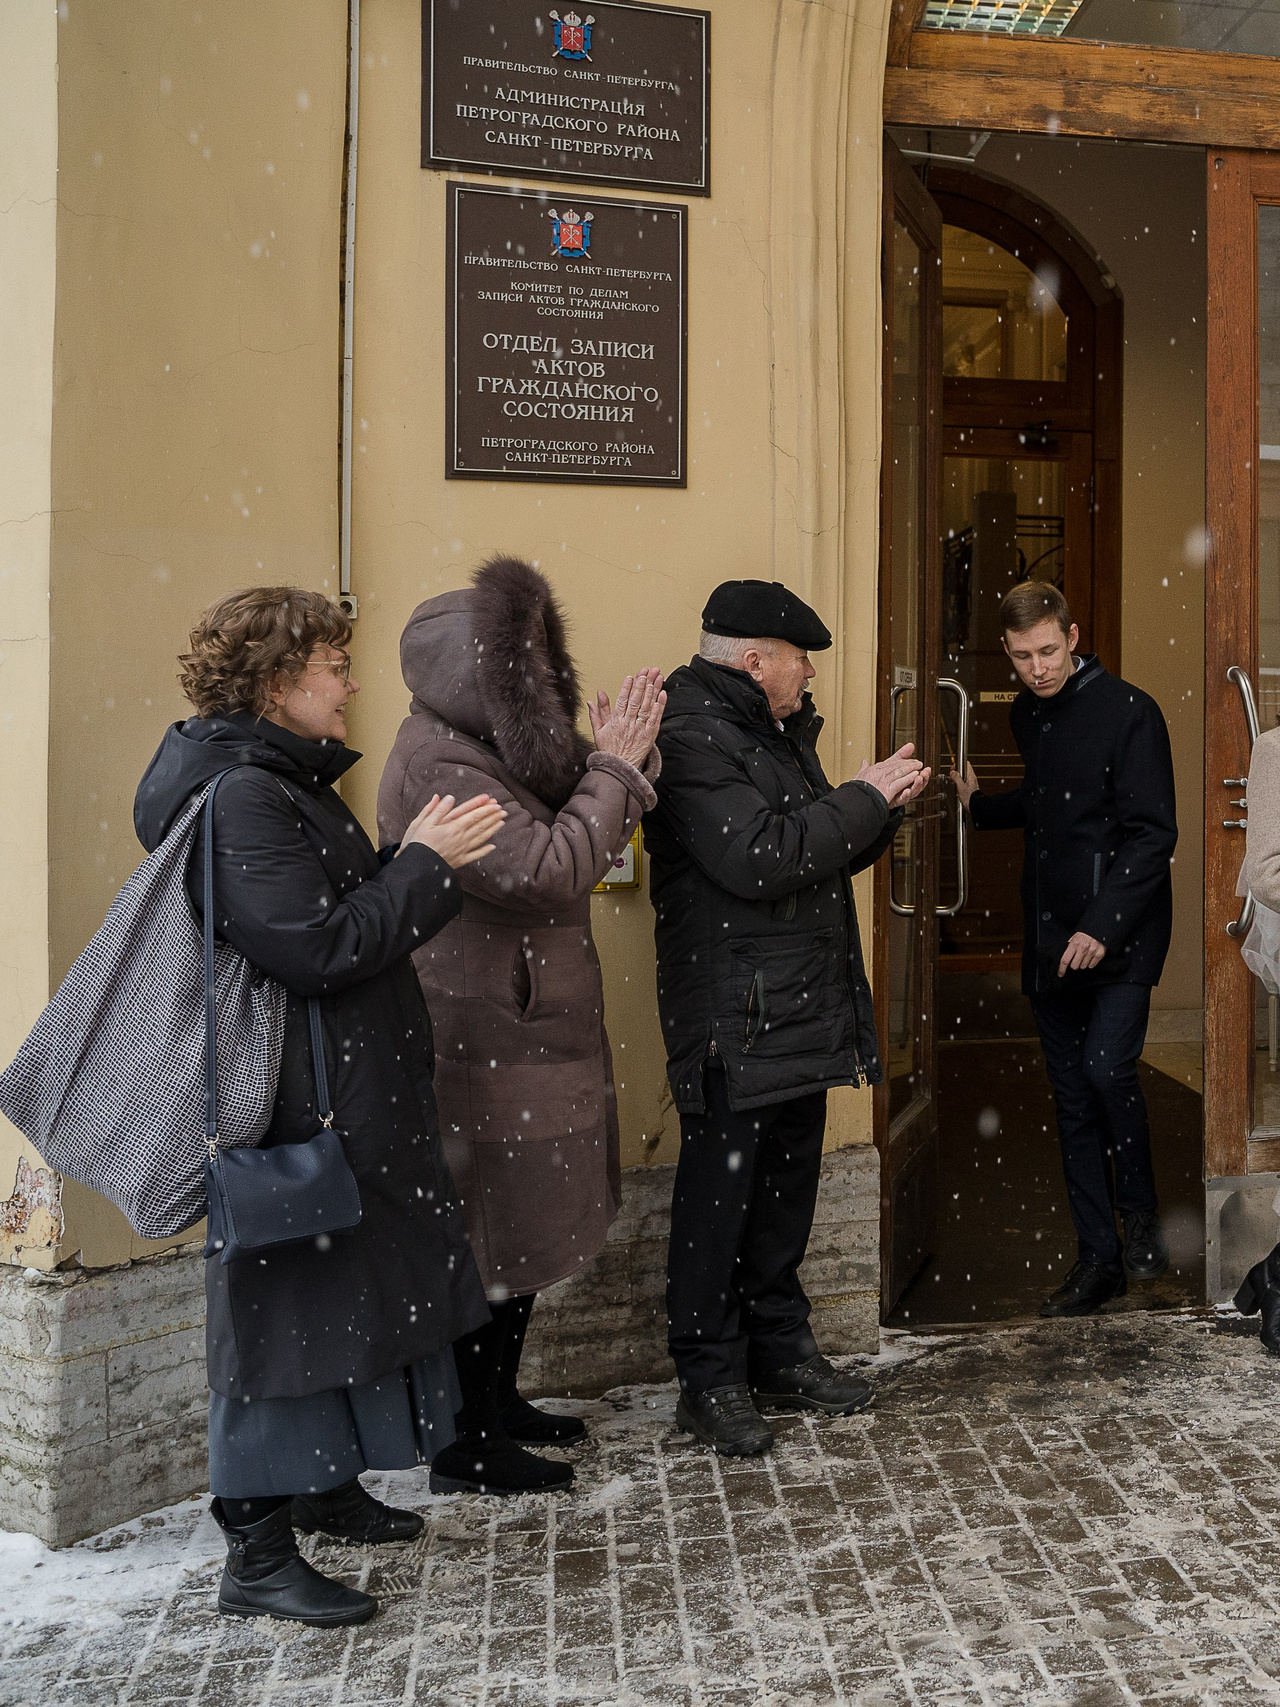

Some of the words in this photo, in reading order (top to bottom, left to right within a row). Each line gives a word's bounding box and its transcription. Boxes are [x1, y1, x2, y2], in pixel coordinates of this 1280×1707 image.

[463, 56, 558, 76] ПРАВИТЕЛЬСТВО
[564, 69, 675, 91] САНКТ-ПЕТЕРБУРГА
[495, 87, 645, 117] АДМИНИСТРАЦИЯ
[456, 104, 608, 134] ПЕТРОГРАДСКОГО
[617, 122, 681, 142] РАЙОНА
[484, 130, 654, 161] САНКТ-ПЕТЕРБУРГА
[464, 255, 559, 272] ПРАВИТЕЛЬСТВО
[565, 264, 673, 282] САНКТ-ПЕТЕРБУРГА
[477, 290, 523, 302] ЗАПИСИ
[528, 294, 566, 306] АКТОВ
[569, 297, 660, 314] ГРАЖДАНСКОГО
[510, 281, 563, 294] КОМИТЕТ
[568, 286, 584, 296] ПО
[589, 288, 629, 299] ДЕЛАМ
[536, 306, 604, 320] СОСТОЯНИЯ
[482, 332, 558, 354] ОТДЕЛ
[570, 338, 655, 360] ЗАПИСИ
[534, 358, 606, 378] АКТОВ
[477, 376, 659, 403] ГРАЖДАНСКОГО
[503, 400, 634, 423] СОСТОЯНИЯ
[481, 436, 598, 453] ПЕТРОГРАДСКОГО
[605, 441, 655, 455] РАЙОНА
[505, 451, 632, 467] САНКТ-ПЕТЕРБУРГА
